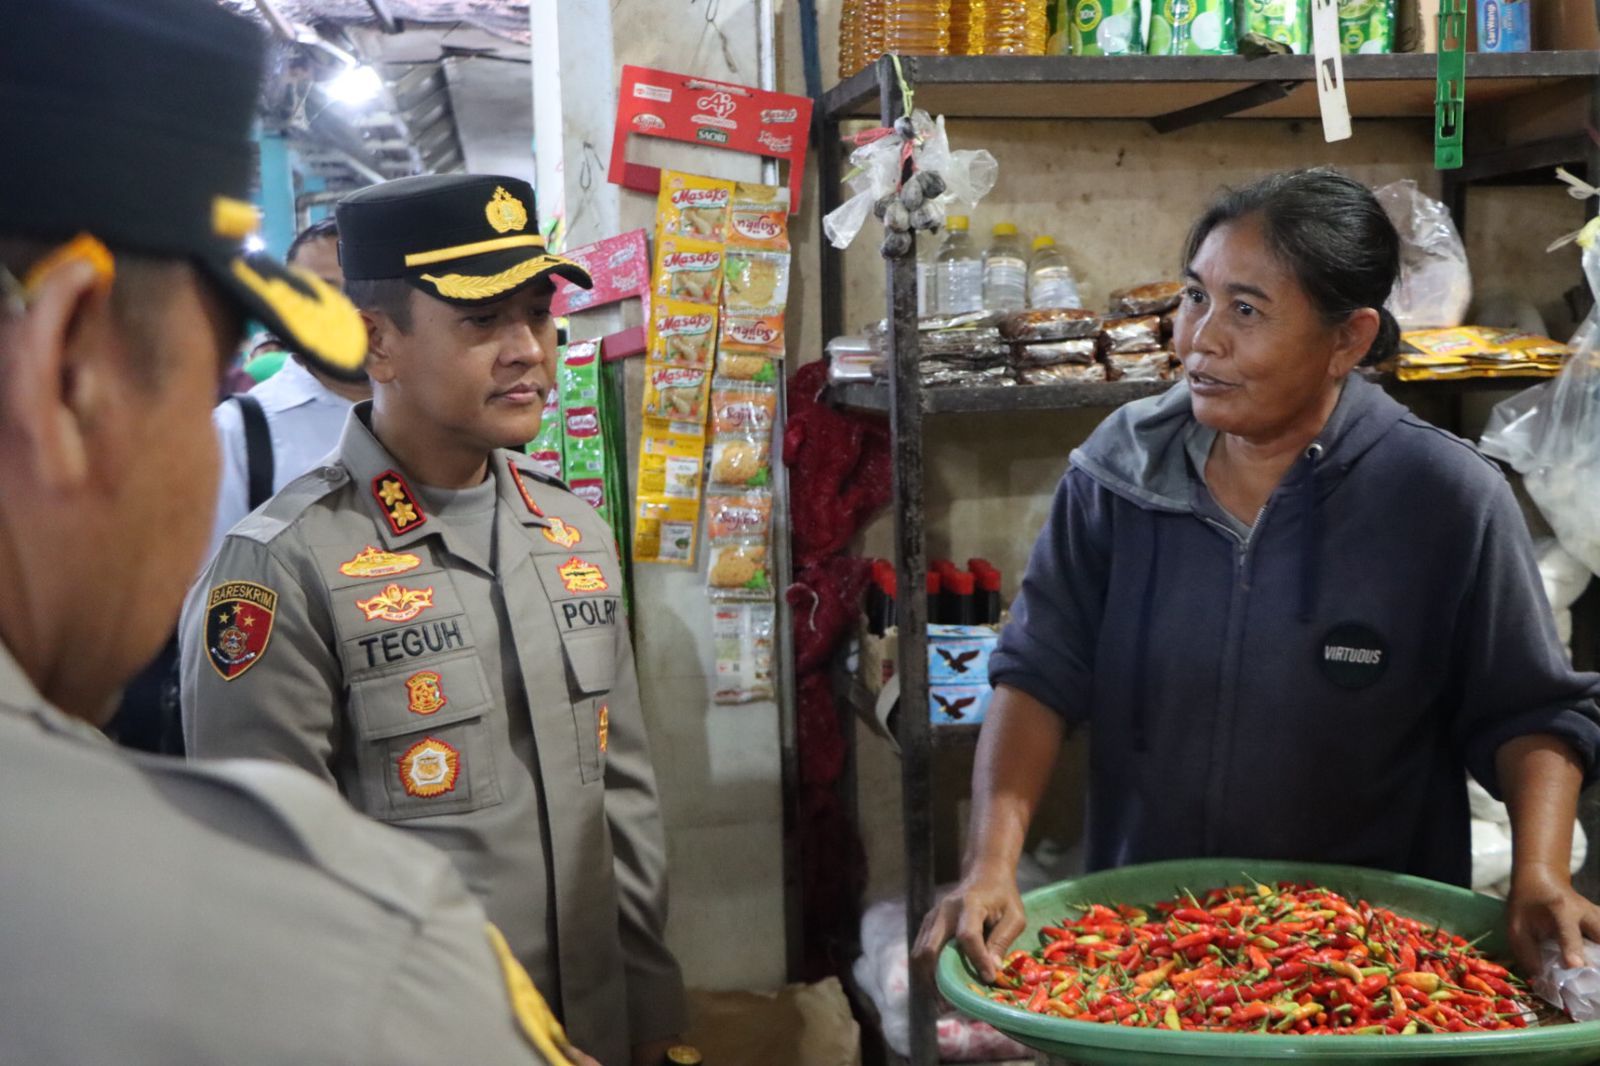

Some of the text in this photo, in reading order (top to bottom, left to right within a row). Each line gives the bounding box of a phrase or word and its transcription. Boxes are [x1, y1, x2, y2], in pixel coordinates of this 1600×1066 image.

[698, 129, 727, 143] SAORI
[672, 188, 729, 205] Masako
[736, 215, 778, 236] Sajiku
[664, 252, 720, 268] Masako
[657, 314, 711, 331] Masako
[732, 320, 774, 342] Sajiku
[652, 368, 704, 386] Masako
[212, 584, 274, 609] BARESKRIM
[562, 599, 617, 629] POLRI
[358, 619, 464, 668] TEGUH
[1324, 645, 1382, 664] VIRTUOUS
